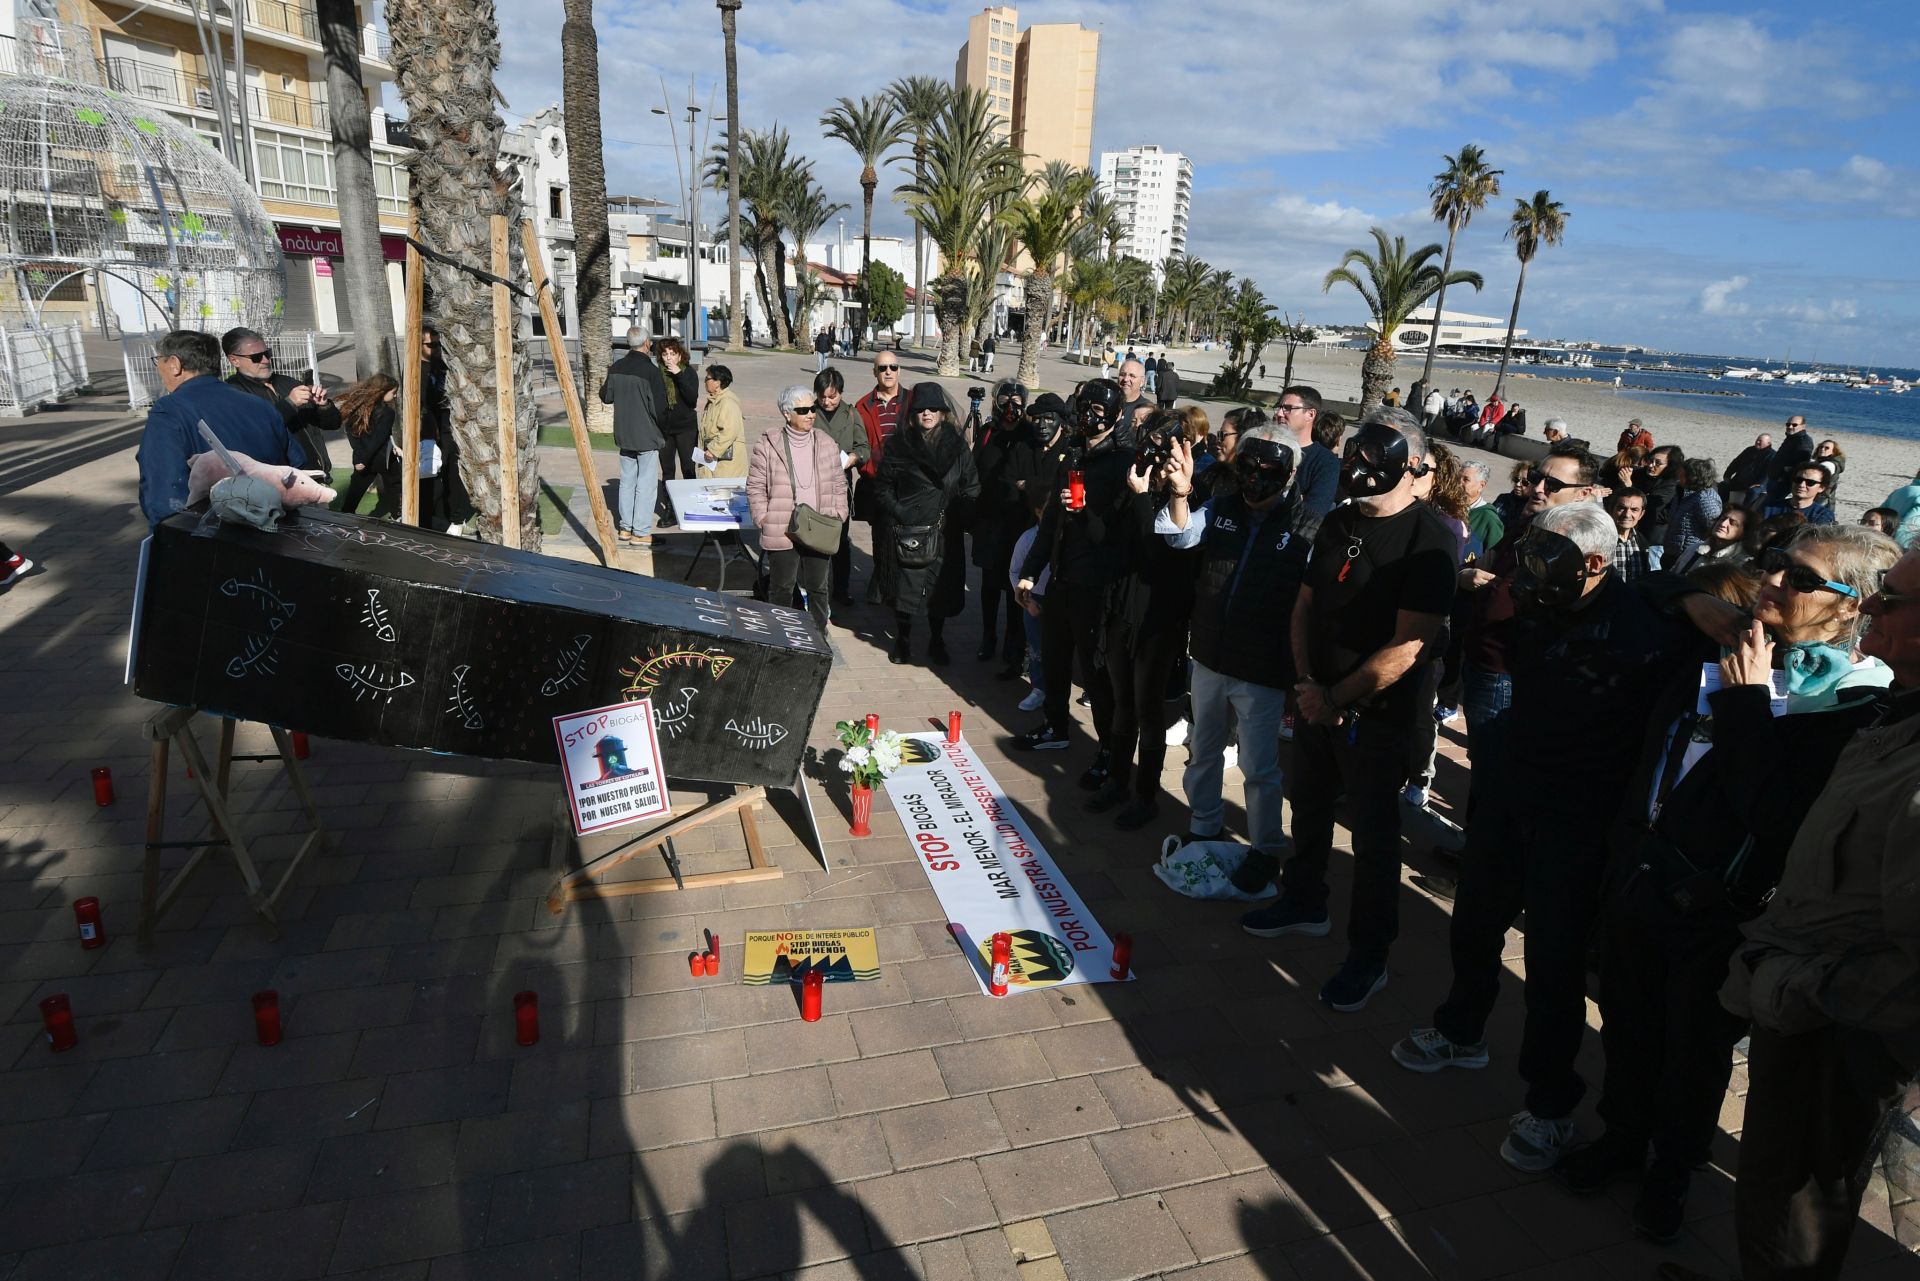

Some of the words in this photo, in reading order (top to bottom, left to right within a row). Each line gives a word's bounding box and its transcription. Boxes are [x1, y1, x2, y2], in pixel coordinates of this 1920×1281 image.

[285, 235, 339, 253] nàtural
[694, 597, 728, 626] RIP
[736, 607, 771, 635] MAR
[771, 608, 817, 650] MENOR
[564, 714, 608, 748] STOP
[596, 789, 629, 804] NUESTRO
[927, 769, 965, 809] MIRADOR
[963, 775, 1009, 823] PRESENTE
[582, 810, 597, 822] POR
[600, 801, 632, 818] NUESTRA
[901, 793, 938, 830] BIOGÁS
[952, 810, 973, 823] EL
[915, 832, 960, 872] STOP
[963, 830, 1003, 870] MENOR
[996, 823, 1034, 858] SALUD
[988, 871, 1021, 899] MAR
[1021, 859, 1075, 917] NUESTRA
[776, 932, 794, 941] NO
[816, 931, 841, 939] INTERÉS
[843, 930, 870, 938] PÚBLICO
[790, 947, 810, 955] MAR
[812, 946, 846, 954] MENOR
[1060, 920, 1098, 952] POR
